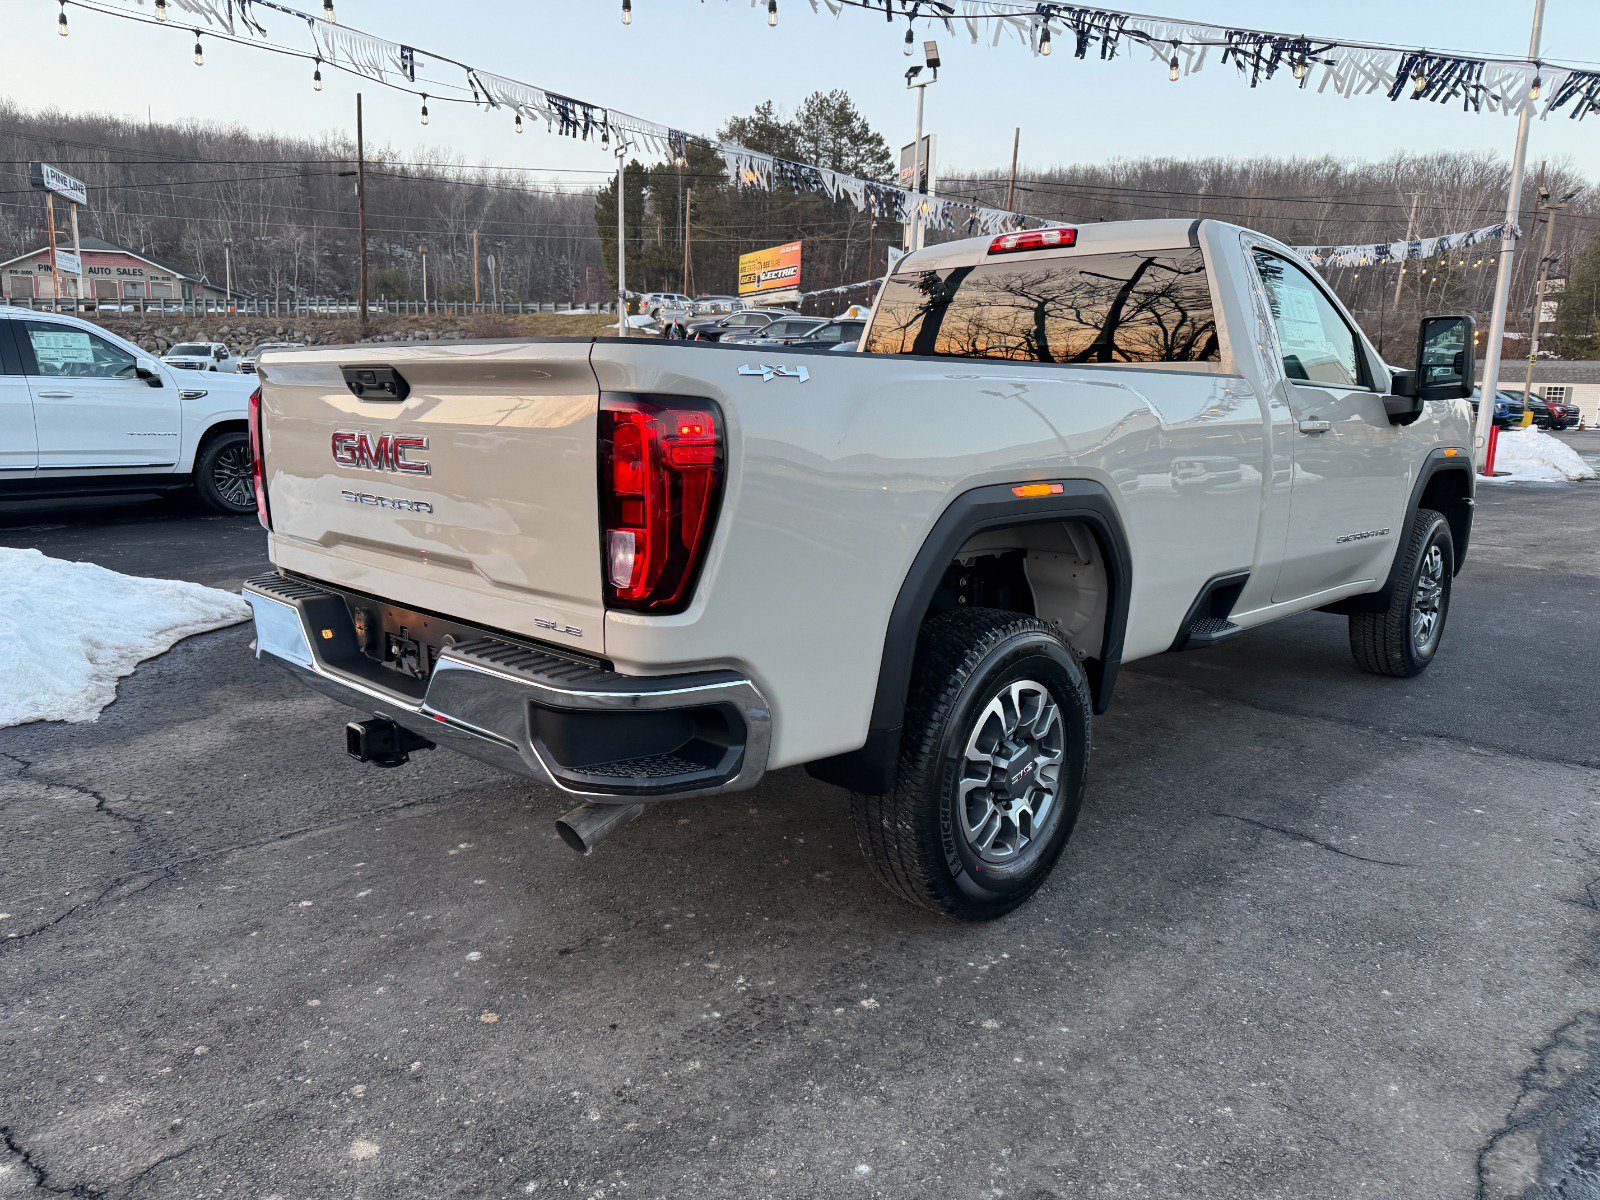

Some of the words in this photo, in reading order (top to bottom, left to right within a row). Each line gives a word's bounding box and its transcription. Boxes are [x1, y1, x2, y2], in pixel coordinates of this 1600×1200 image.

[50, 169, 68, 187] PINE
[68, 178, 85, 195] LINE
[88, 267, 111, 275] AUTO
[116, 268, 144, 276] SALES
[331, 429, 431, 476] GMC
[341, 489, 434, 514] SIERRA
[534, 618, 583, 637] SLE
